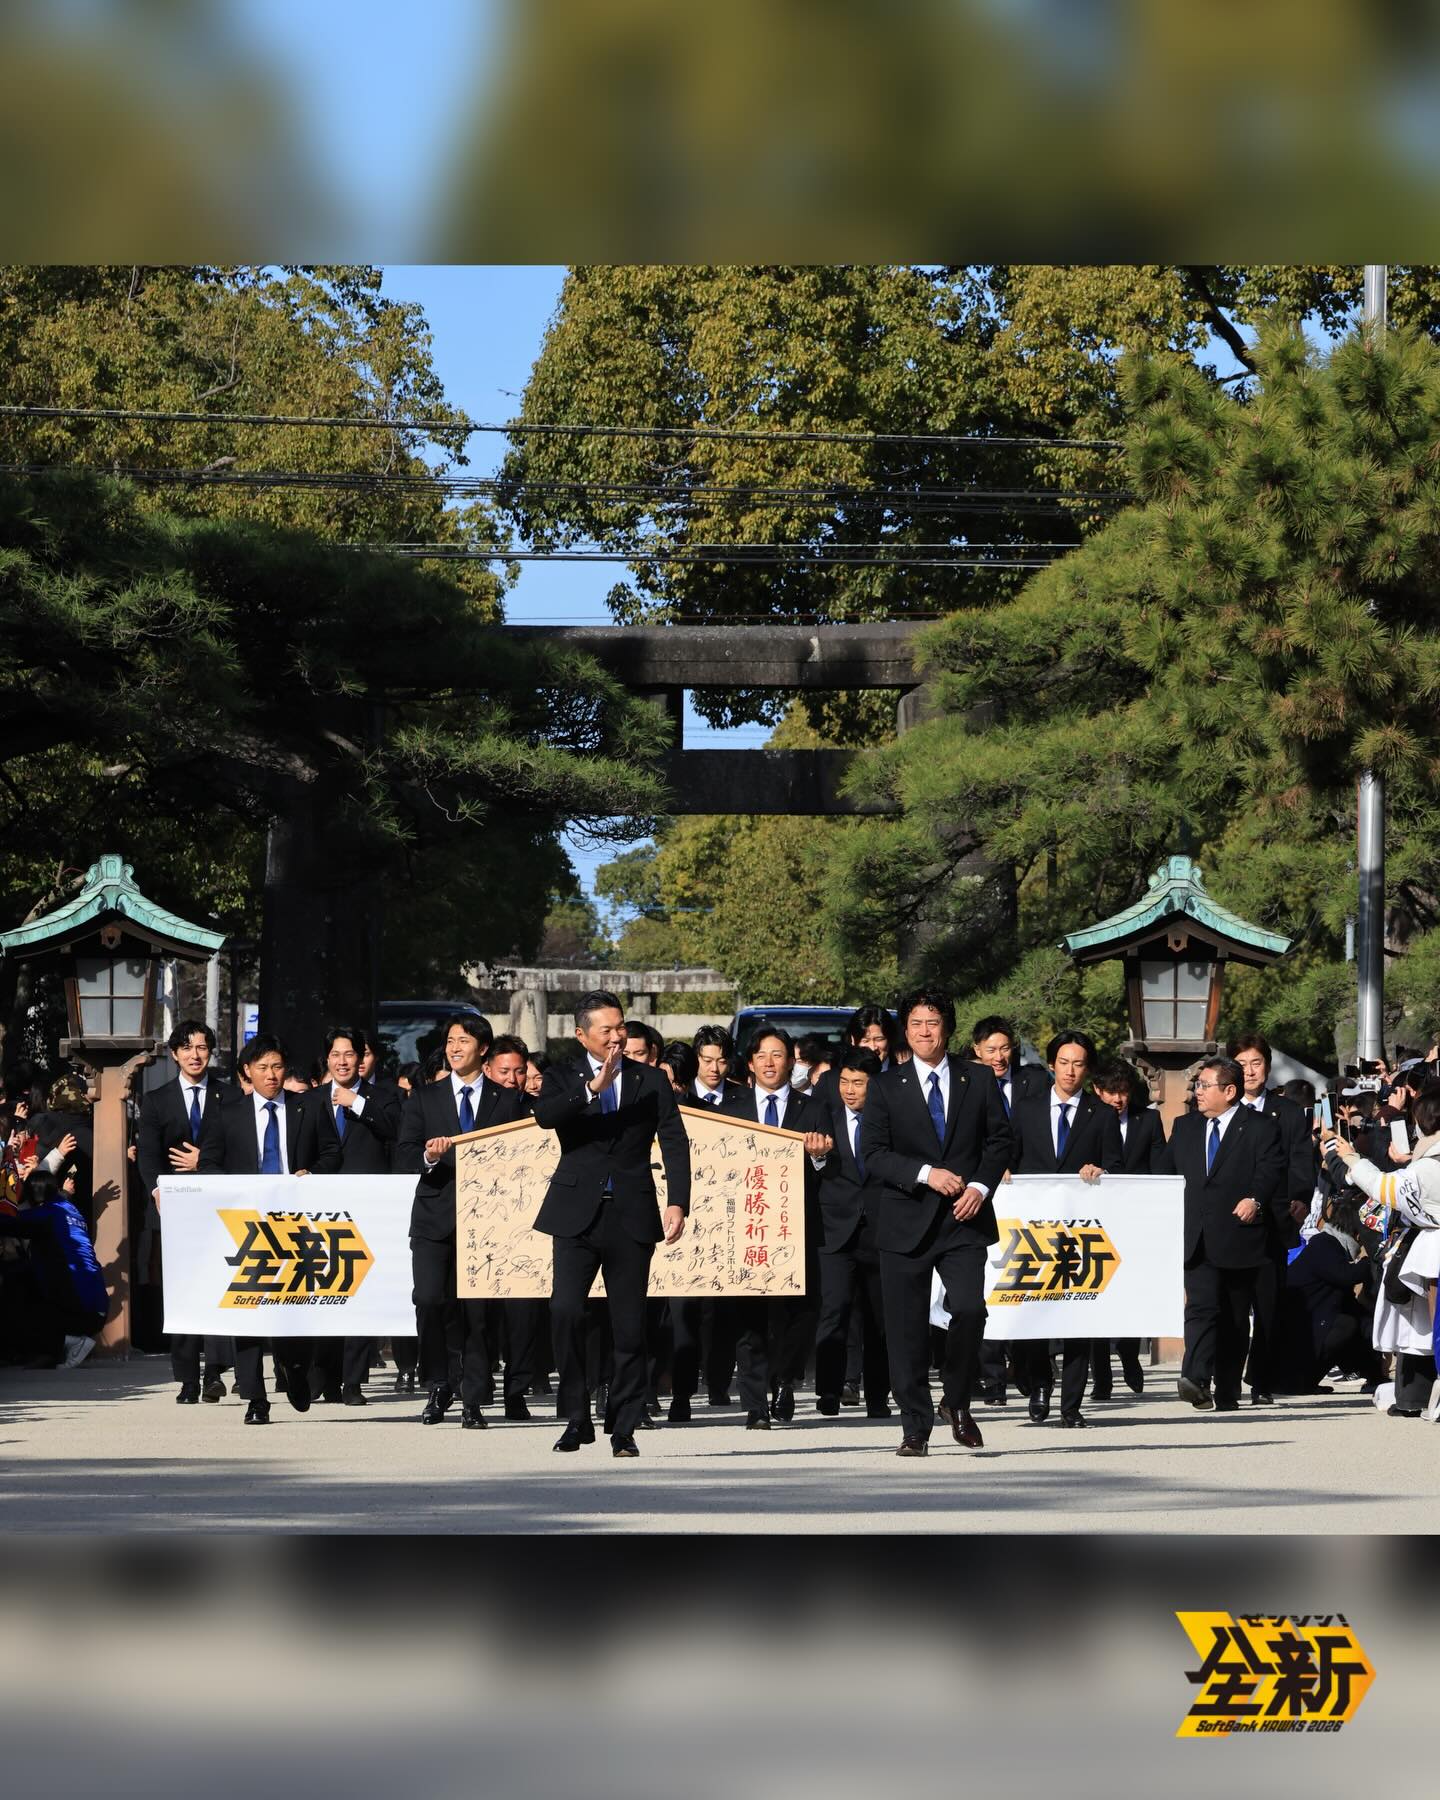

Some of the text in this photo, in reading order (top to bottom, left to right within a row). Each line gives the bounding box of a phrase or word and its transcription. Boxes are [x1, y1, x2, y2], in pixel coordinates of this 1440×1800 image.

[744, 1164, 770, 1268] 優勝祈願
[777, 1165, 792, 1241] 2026年
[224, 1221, 368, 1292] 全新
[726, 1198, 736, 1285] 福岡ソフトバンクホークス
[991, 1228, 1116, 1291] 全新
[233, 1295, 349, 1305] SoftBank HAWKS 2026
[999, 1291, 1099, 1303] SoftBank HAWKS 2026
